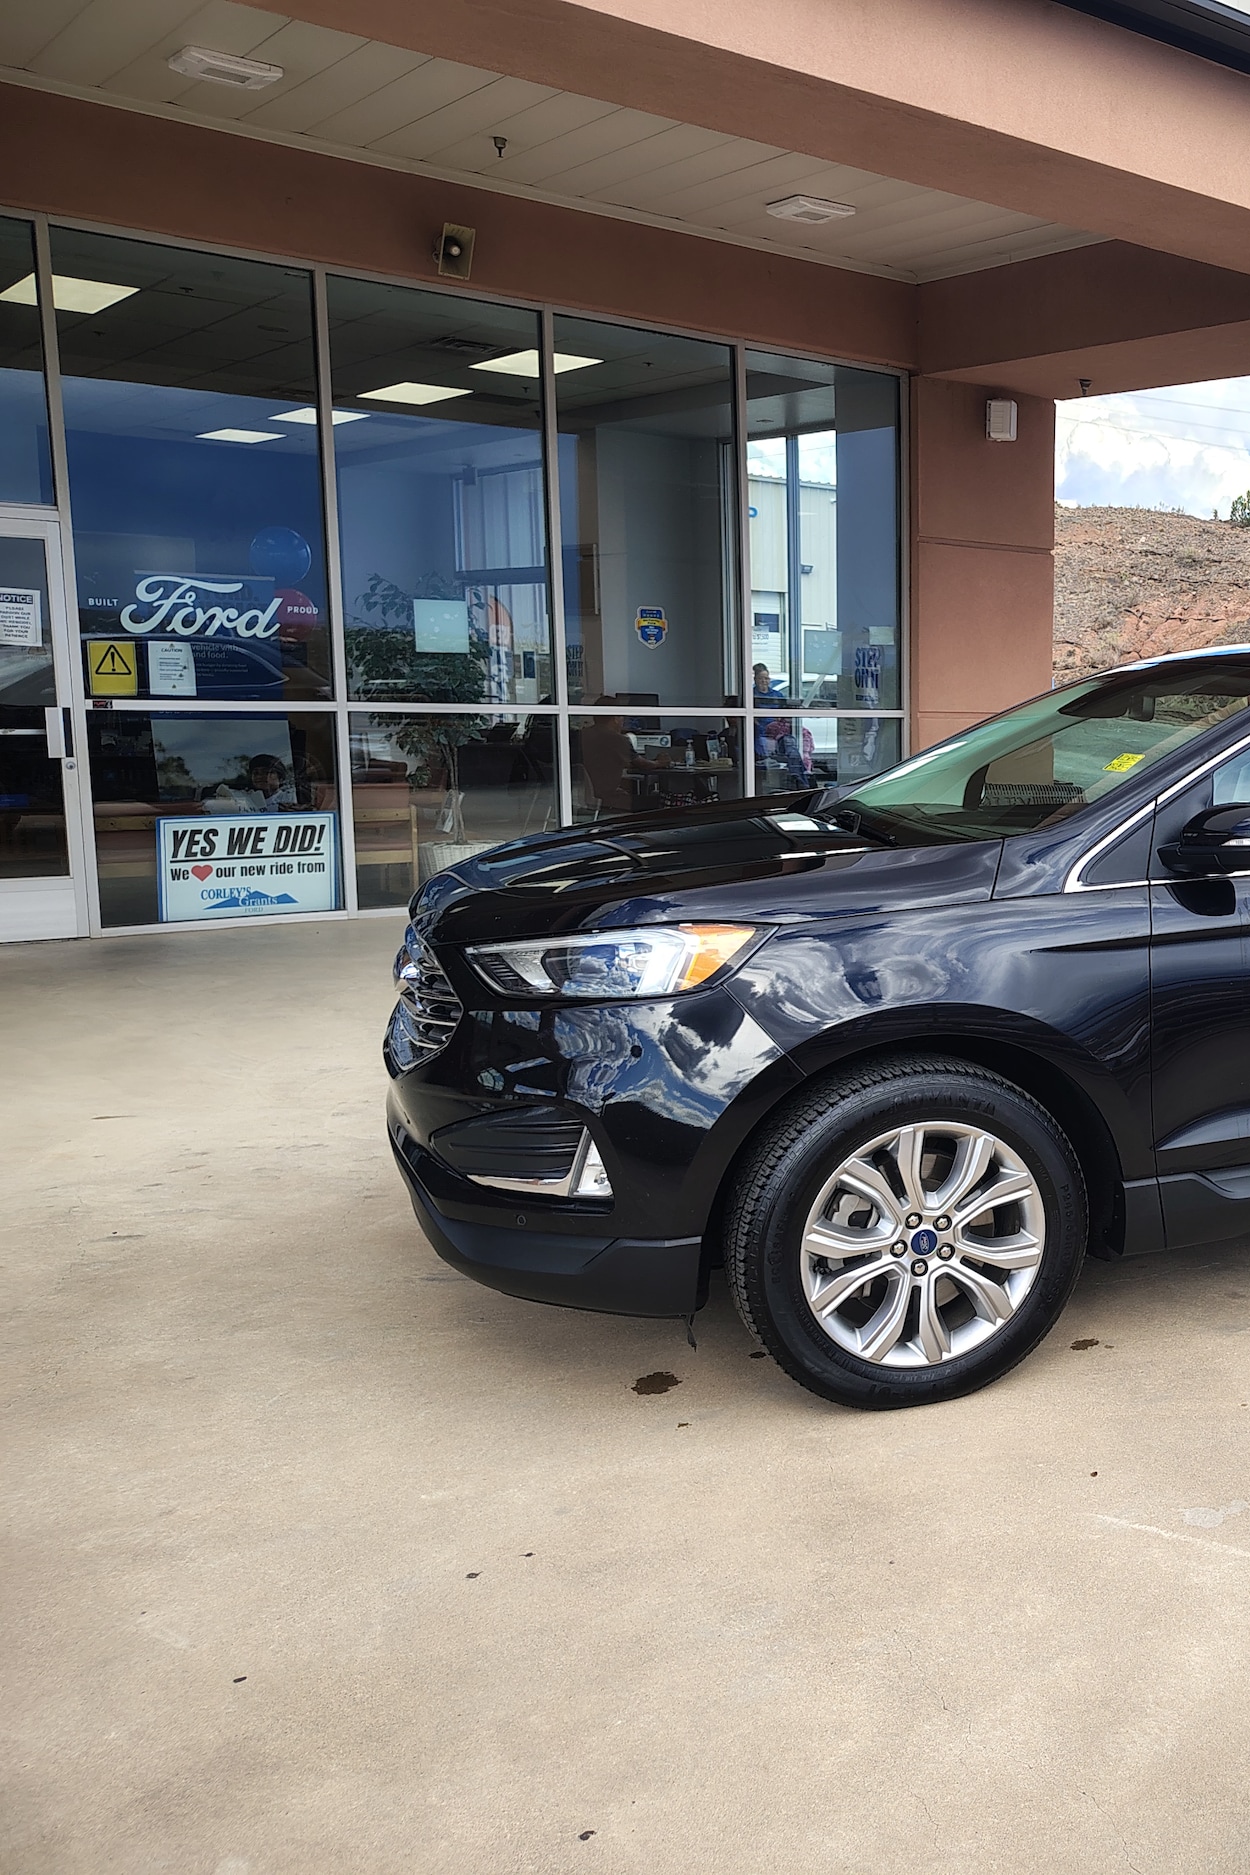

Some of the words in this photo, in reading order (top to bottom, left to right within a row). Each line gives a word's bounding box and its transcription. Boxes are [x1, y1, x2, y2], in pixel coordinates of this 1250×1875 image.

[88, 598, 118, 607] BUILT
[120, 576, 284, 638] Ford
[287, 605, 319, 615] PROUD
[171, 828, 219, 859] YES
[227, 826, 268, 856] WE
[273, 824, 326, 854] DID!
[170, 868, 190, 881] We
[215, 866, 237, 878] our
[240, 864, 266, 877] new
[270, 861, 294, 875] ride
[297, 861, 325, 874] from
[201, 886, 252, 900] CORLEY'S
[238, 896, 278, 907] Grants
[244, 906, 264, 914] FORD
